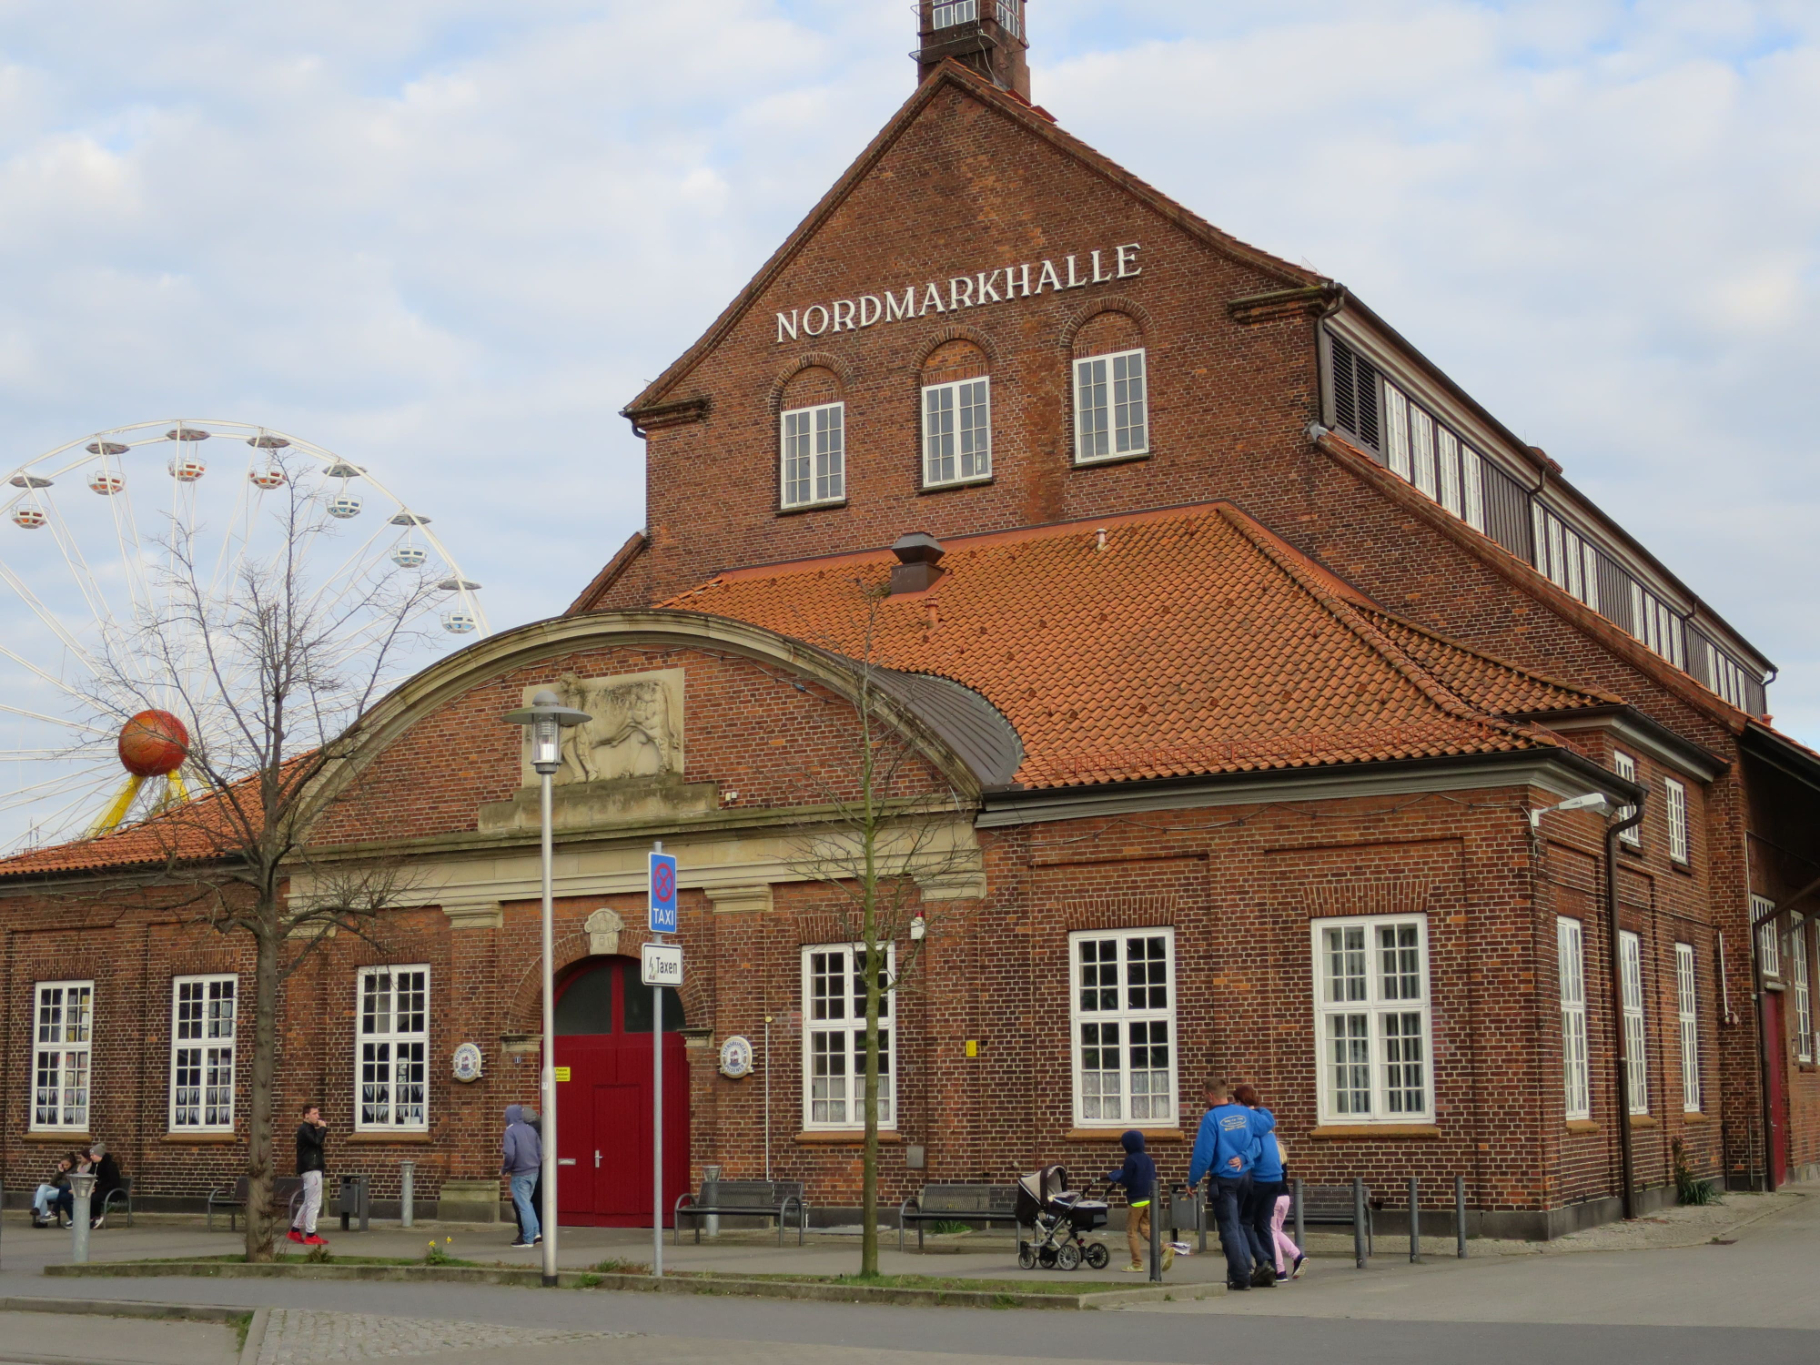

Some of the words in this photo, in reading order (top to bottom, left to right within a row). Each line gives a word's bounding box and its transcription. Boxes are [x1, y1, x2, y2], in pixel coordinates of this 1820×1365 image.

[775, 243, 1144, 343] NORDMARKHALLE
[653, 908, 674, 926] TAXI
[656, 957, 678, 974] Taxen
